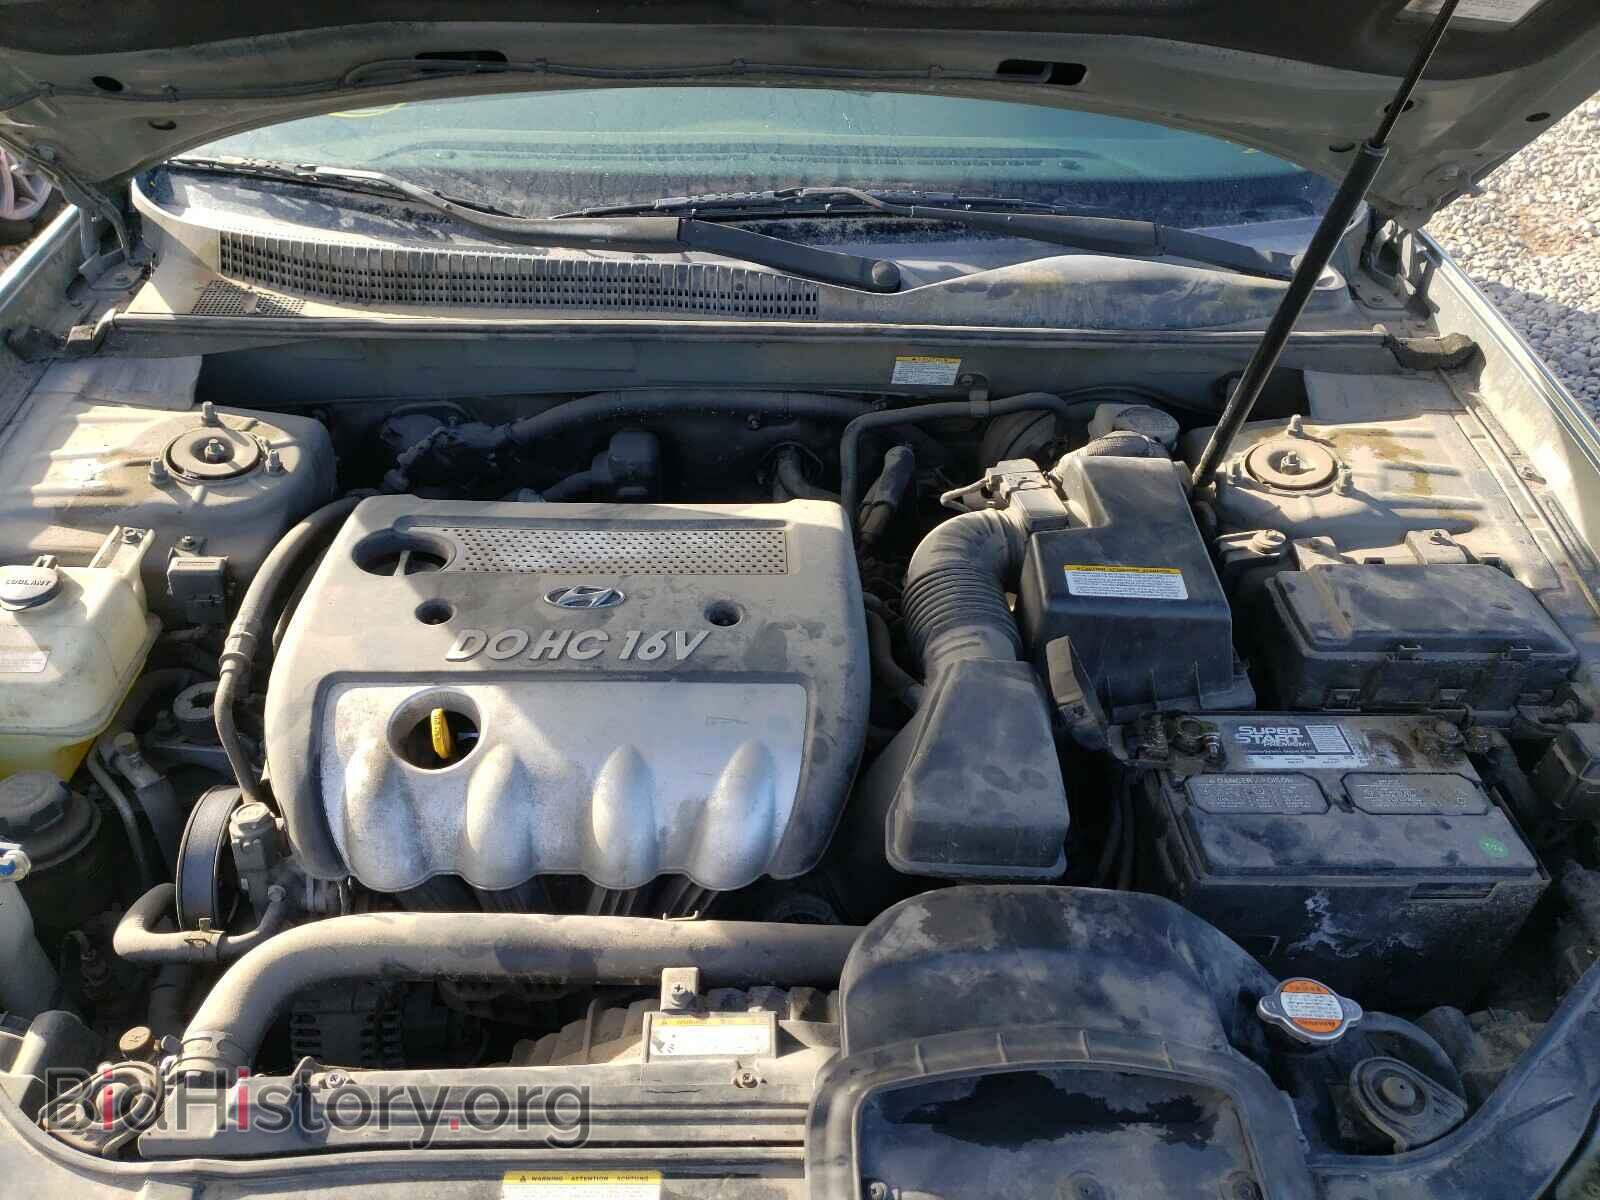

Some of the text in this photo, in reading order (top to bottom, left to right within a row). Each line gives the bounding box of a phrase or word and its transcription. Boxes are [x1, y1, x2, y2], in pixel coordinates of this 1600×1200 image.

[6, 578, 51, 586] COOLANT
[446, 629, 711, 662] DOHC 16V
[1238, 726, 1300, 735] SUPER
[1235, 734, 1304, 744] START
